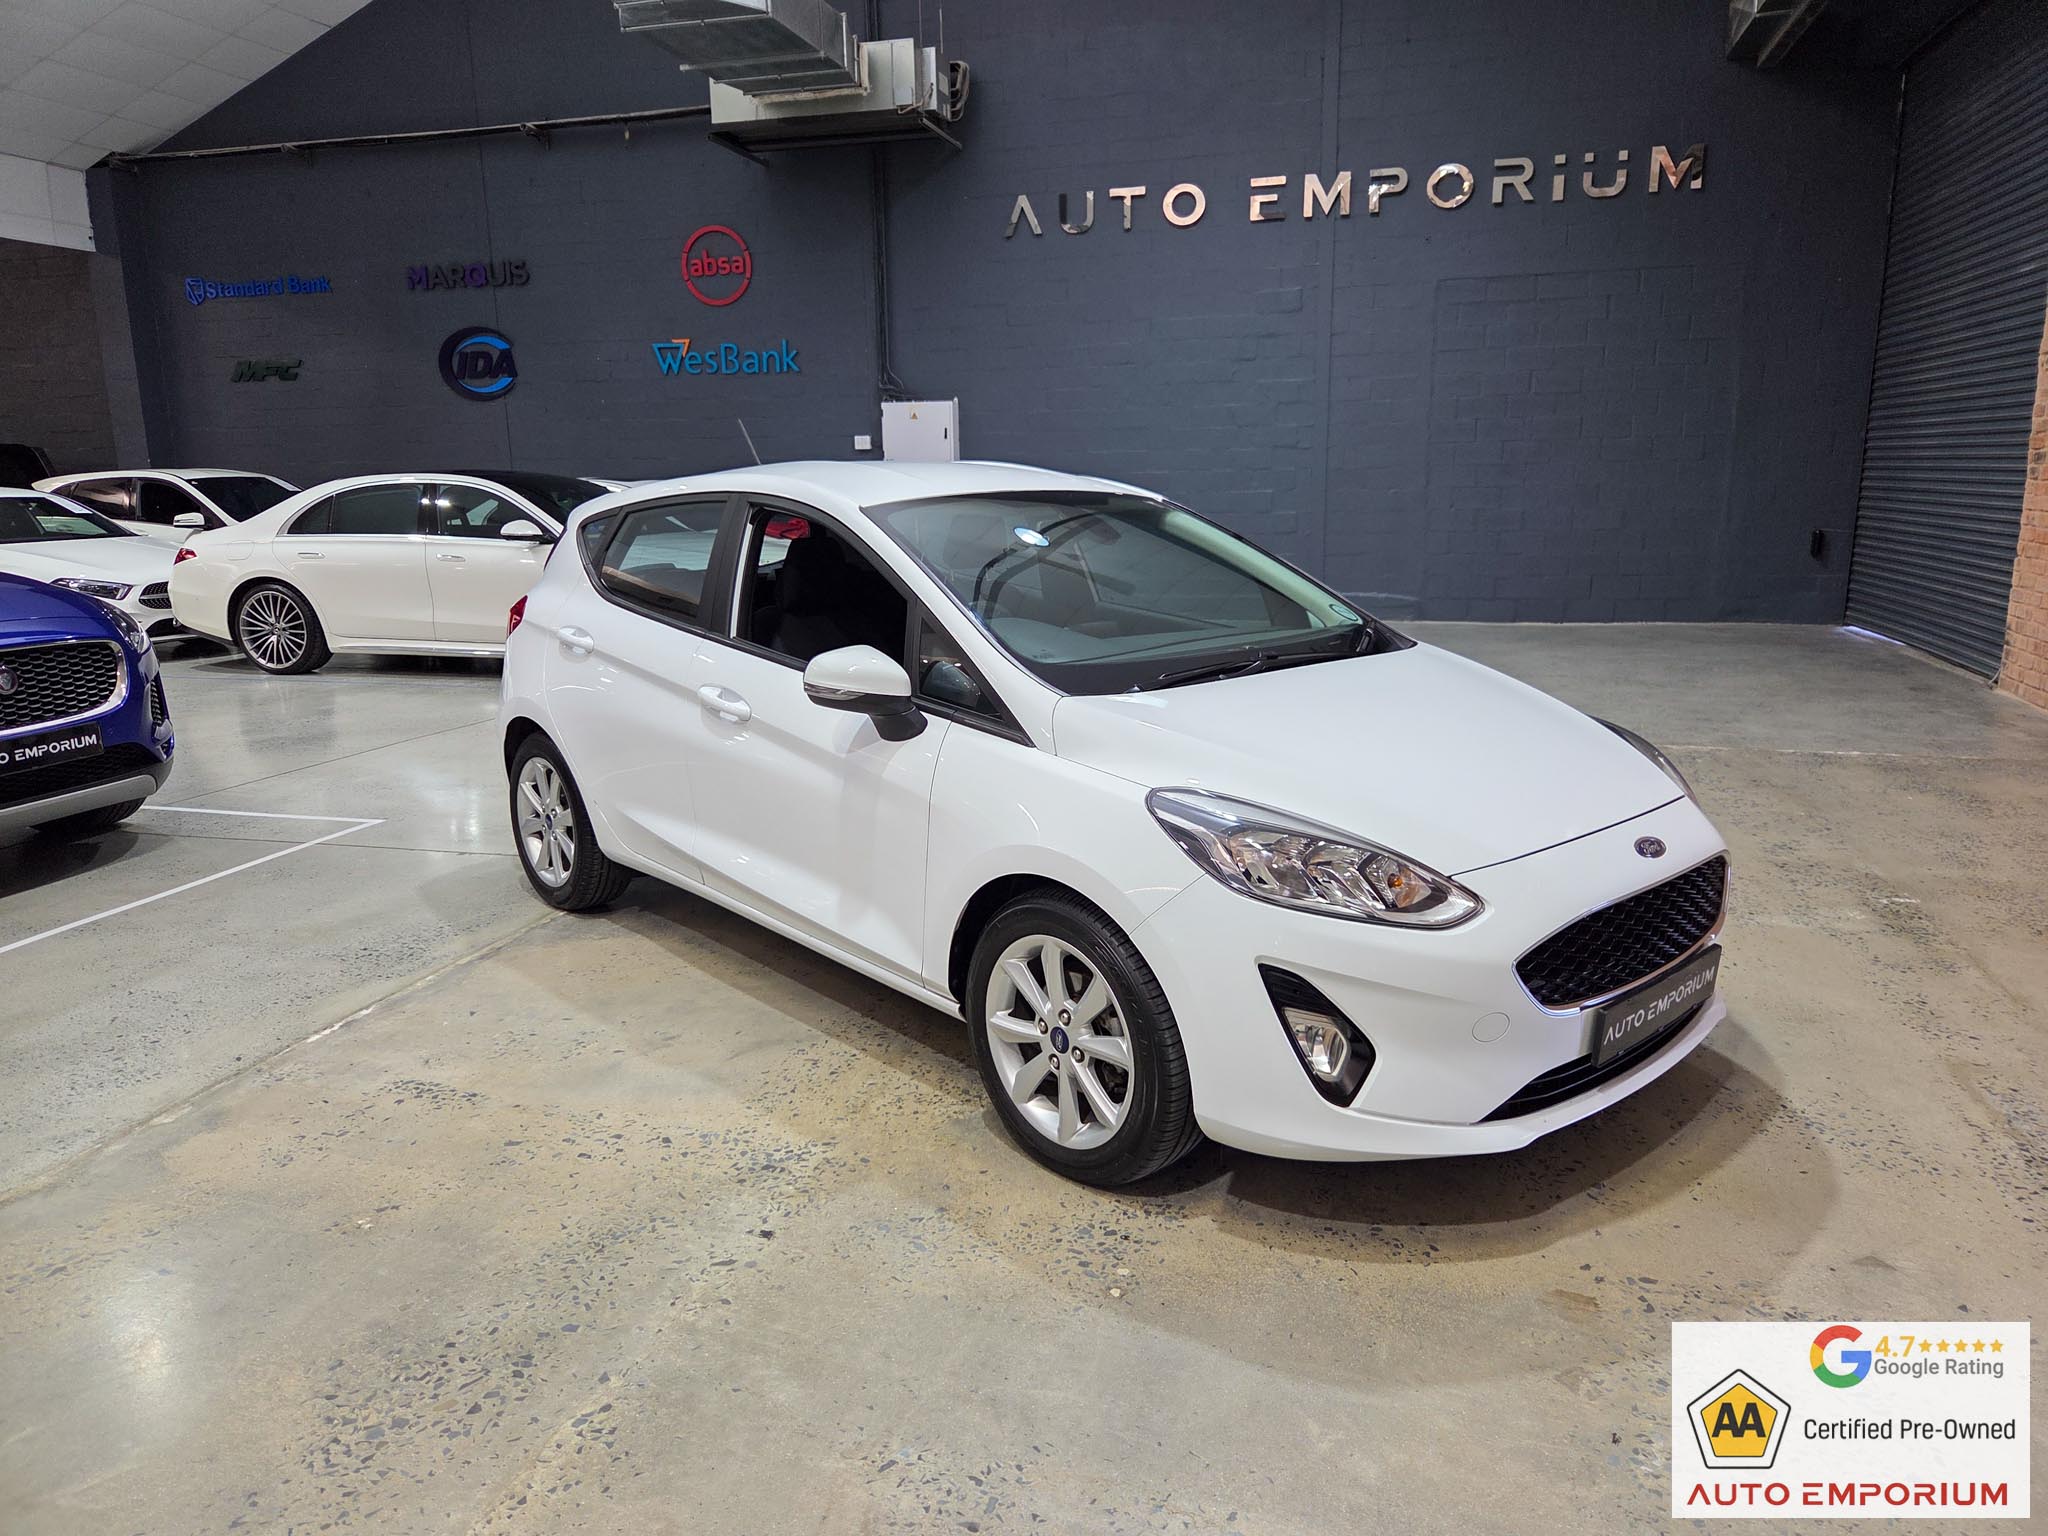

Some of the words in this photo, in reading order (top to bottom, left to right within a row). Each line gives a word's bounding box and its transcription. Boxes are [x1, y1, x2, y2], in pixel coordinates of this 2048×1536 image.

[1005, 181, 1207, 238] AUTO
[407, 261, 530, 290] MARQUIS
[690, 250, 745, 277] absa
[205, 277, 284, 299] Standard
[287, 274, 331, 294] Bank
[652, 338, 800, 375] WesBank
[14, 734, 98, 761] EMPORIUM
[1603, 1009, 1645, 1046] AUTO
[1647, 966, 1715, 1020] EMPORIUM
